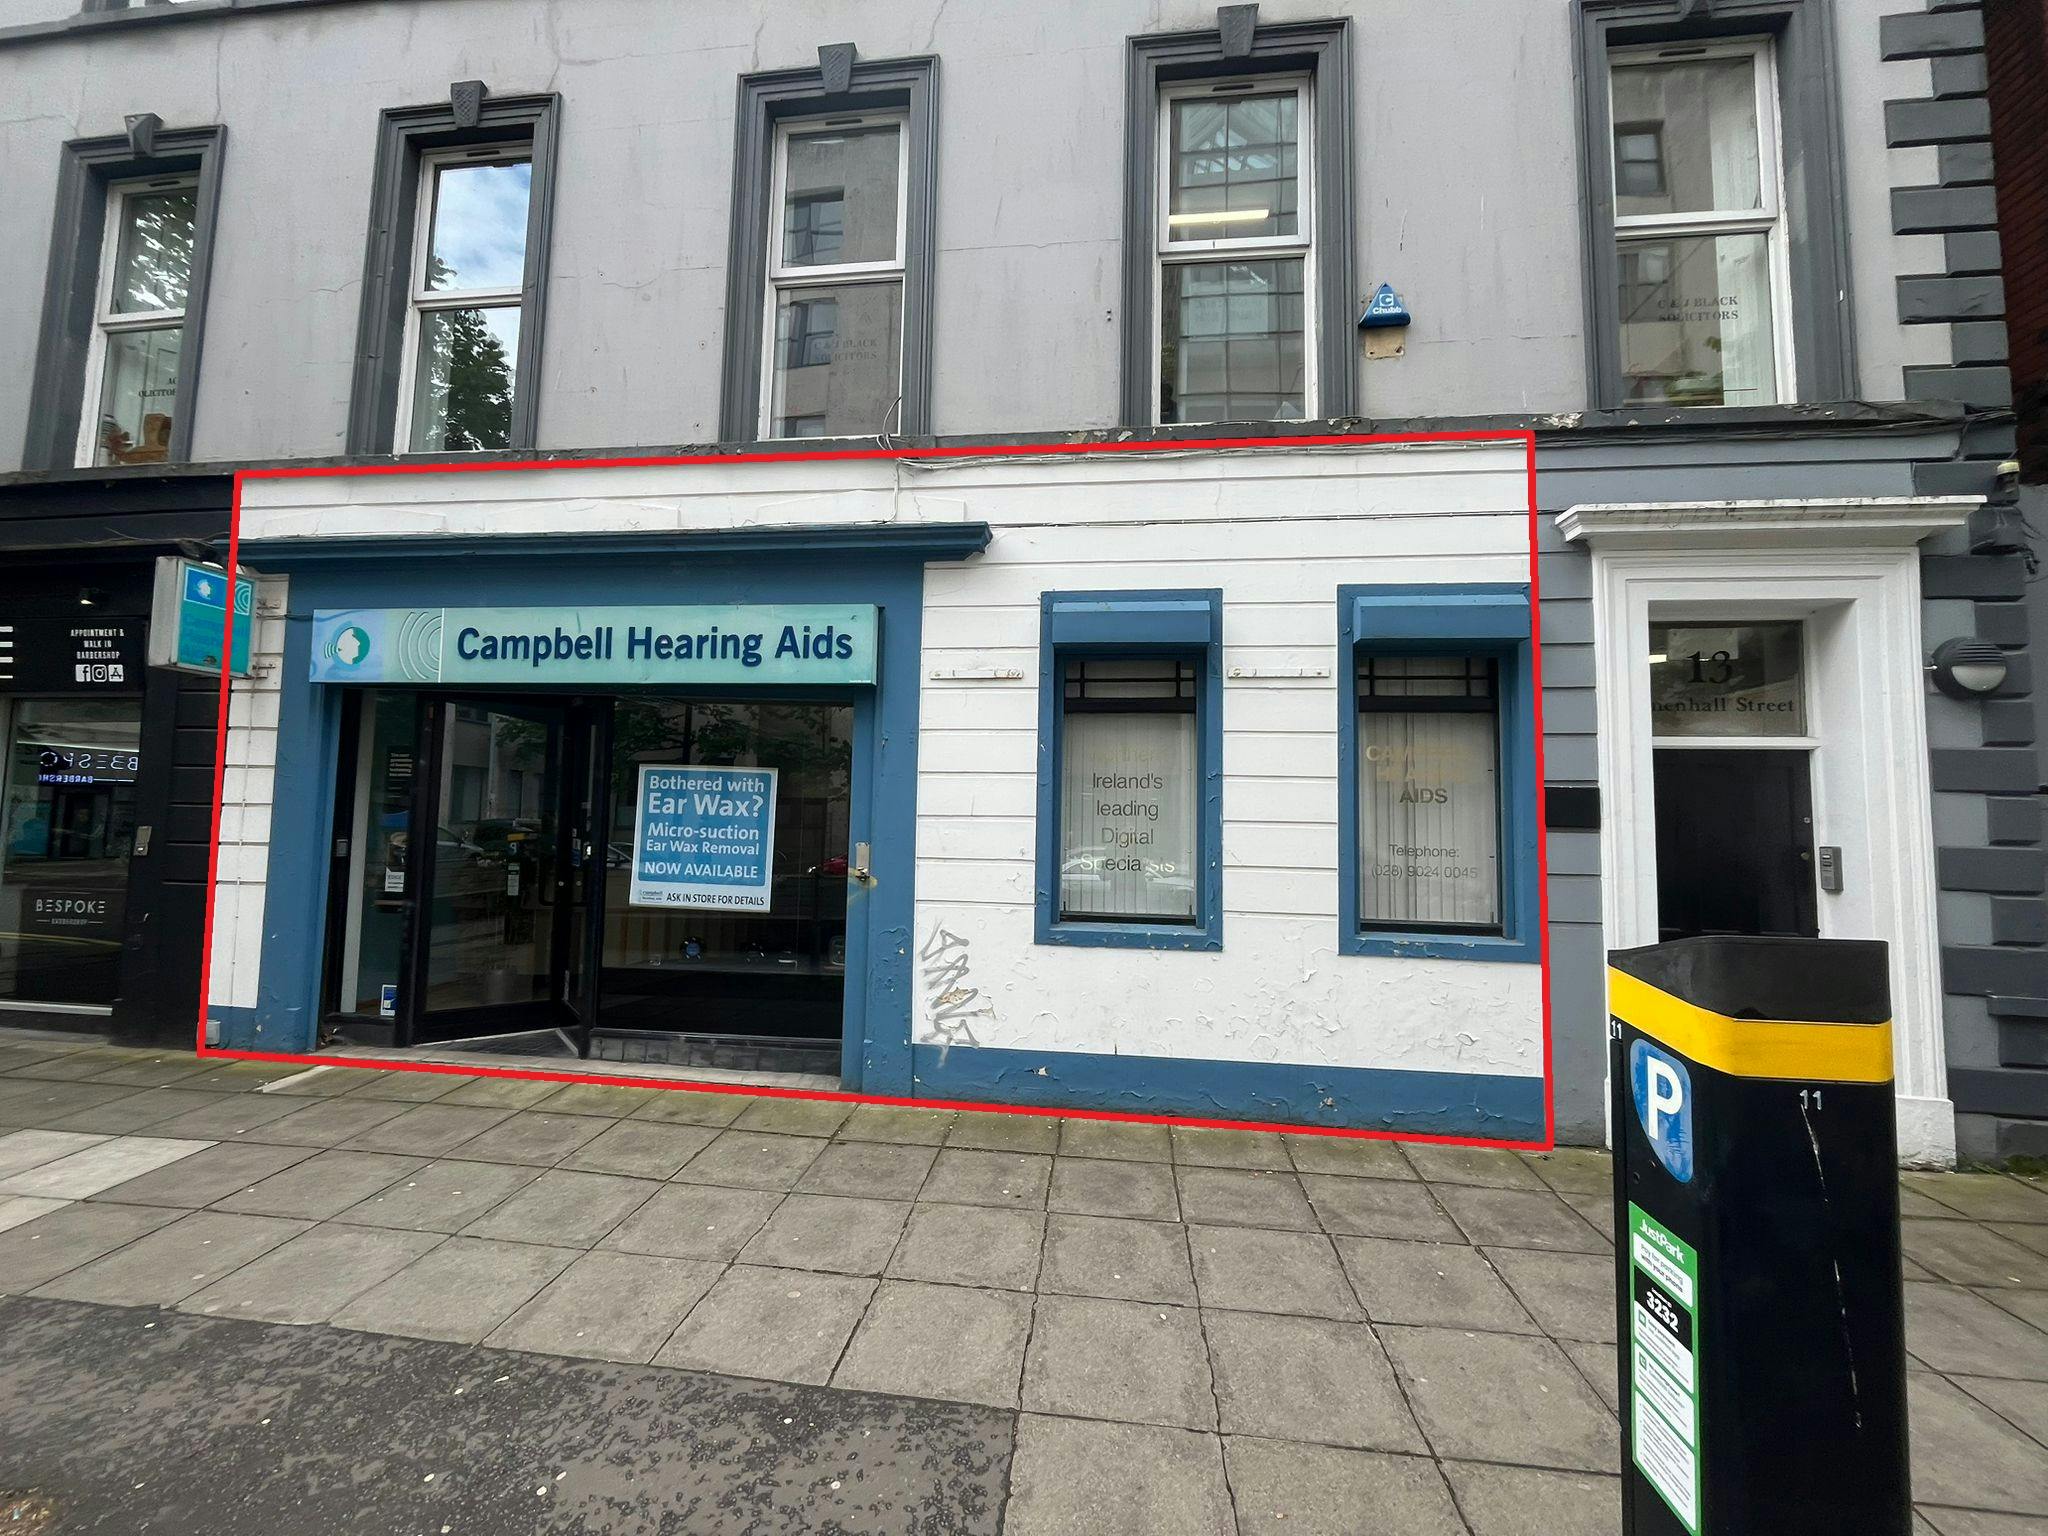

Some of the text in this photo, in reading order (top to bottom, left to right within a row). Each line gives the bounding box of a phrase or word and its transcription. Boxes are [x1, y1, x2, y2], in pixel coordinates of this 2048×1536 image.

[1372, 306, 1402, 315] Chubb
[1694, 296, 1738, 307] BLACK
[70, 628, 117, 638] APPOINTMENT
[83, 640, 101, 649] WALK
[457, 624, 853, 668] Campbell Hearing Aids
[76, 652, 120, 660] BARBERSHOP
[1686, 650, 1733, 684] 13
[1736, 697, 1796, 713] Street
[650, 775, 764, 793] Bothered with
[1092, 772, 1163, 790] Ireland's
[648, 792, 764, 817] Ear Wax?
[1399, 788, 1448, 804] AIDS
[1096, 799, 1159, 821] leading
[647, 822, 759, 840] Micro-suction
[1101, 827, 1154, 849] Digital
[646, 839, 760, 856] Ear Wax Removal
[1388, 844, 1460, 859] Telephone:
[644, 861, 758, 879] NOW AVAILABLE
[1371, 864, 1403, 879] (028)
[1407, 866, 1438, 878] 9024
[35, 899, 106, 914] BESPOKE
[666, 893, 681, 903] ASK
[683, 894, 691, 903] IN
[693, 894, 716, 904] STORE
[718, 895, 734, 905] FOR
[735, 896, 765, 906] DETAILS
[1647, 1055, 1683, 1141] P
[1800, 1089, 1822, 1111] 11
[1640, 1219, 1685, 1264] JustPark
[1646, 1290, 1679, 1333] 3232
